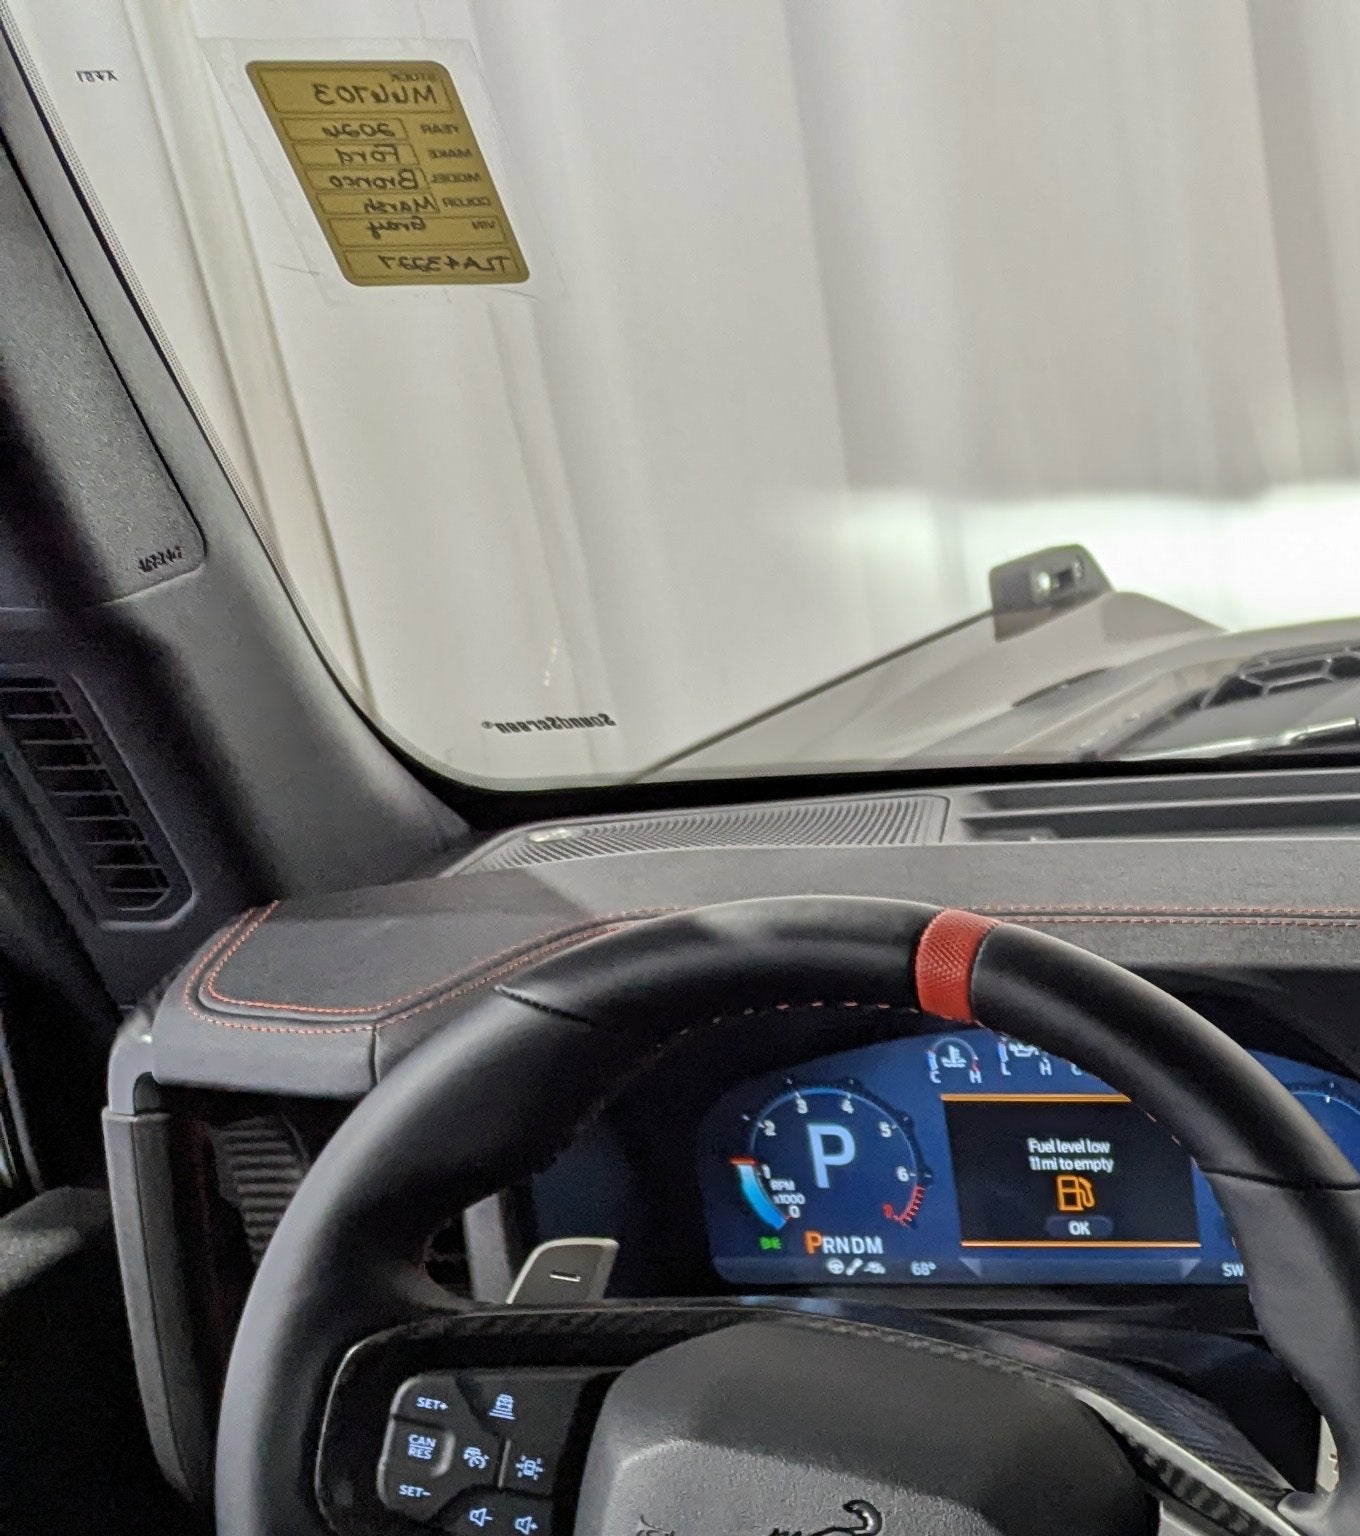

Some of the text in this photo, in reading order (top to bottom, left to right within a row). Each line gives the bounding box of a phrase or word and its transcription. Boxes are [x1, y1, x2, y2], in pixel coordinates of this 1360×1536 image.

[969, 1070, 982, 1083] H
[796, 1098, 809, 1114] 3
[841, 1099, 854, 1114] 4
[763, 1120, 776, 1136] 2
[878, 1122, 892, 1137] 5
[1027, 1138, 1111, 1153] Fuel level low
[807, 1122, 856, 1189] P
[1041, 1156, 1058, 1170] mi
[1059, 1156, 1074, 1170] to
[1074, 1157, 1114, 1173] empty
[896, 1166, 910, 1182] 6
[769, 1180, 795, 1191] RPM
[1068, 1220, 1091, 1236] OK
[408, 1434, 437, 1448] CAN
[407, 1447, 433, 1460] RES
